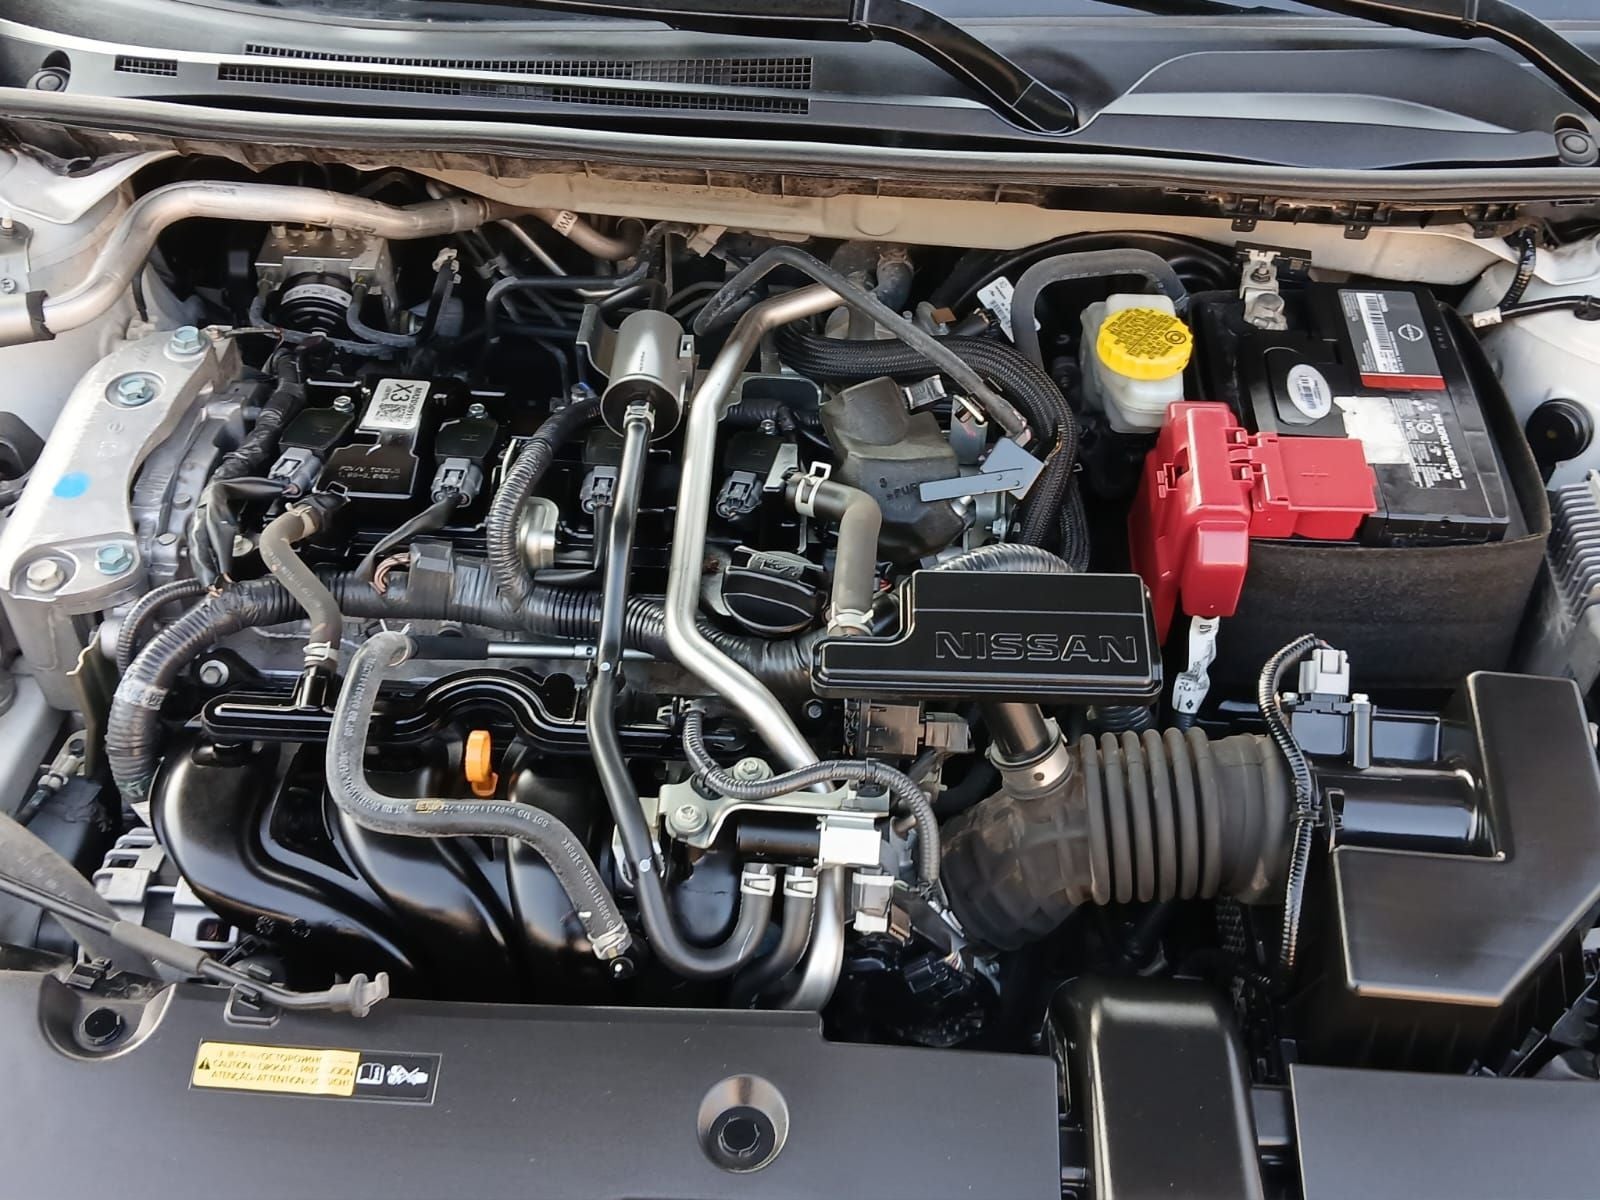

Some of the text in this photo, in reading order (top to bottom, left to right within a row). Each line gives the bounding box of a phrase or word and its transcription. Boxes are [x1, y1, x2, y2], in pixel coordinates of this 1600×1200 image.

[389, 383, 415, 402] X3
[935, 631, 1138, 663] NISSAN
[212, 1059, 251, 1071] CAUTION
